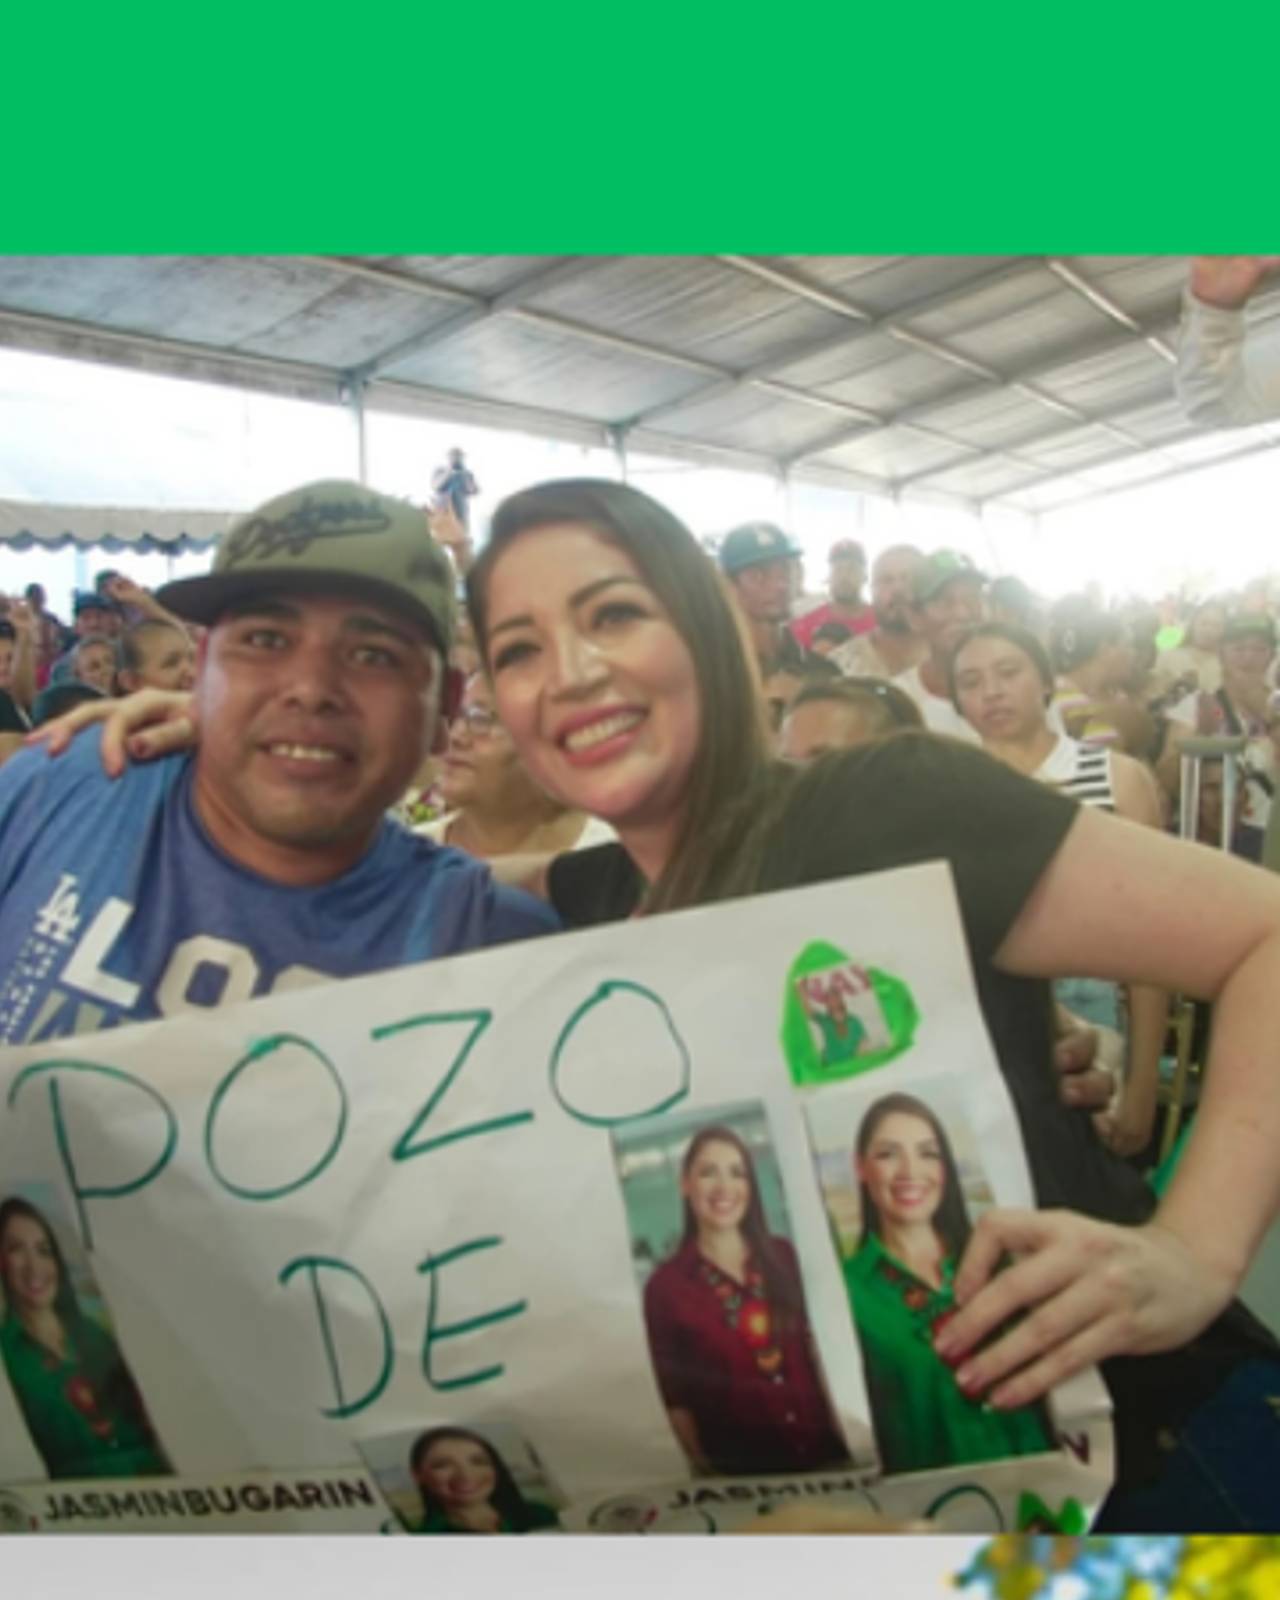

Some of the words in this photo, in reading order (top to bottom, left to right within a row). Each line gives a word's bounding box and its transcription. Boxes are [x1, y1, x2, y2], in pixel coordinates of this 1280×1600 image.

[59, 895, 345, 1020] LO
[8, 980, 690, 1250] POZO
[280, 1238, 527, 1418] DE
[42, 1478, 376, 1521] JASMINBUGARIN
